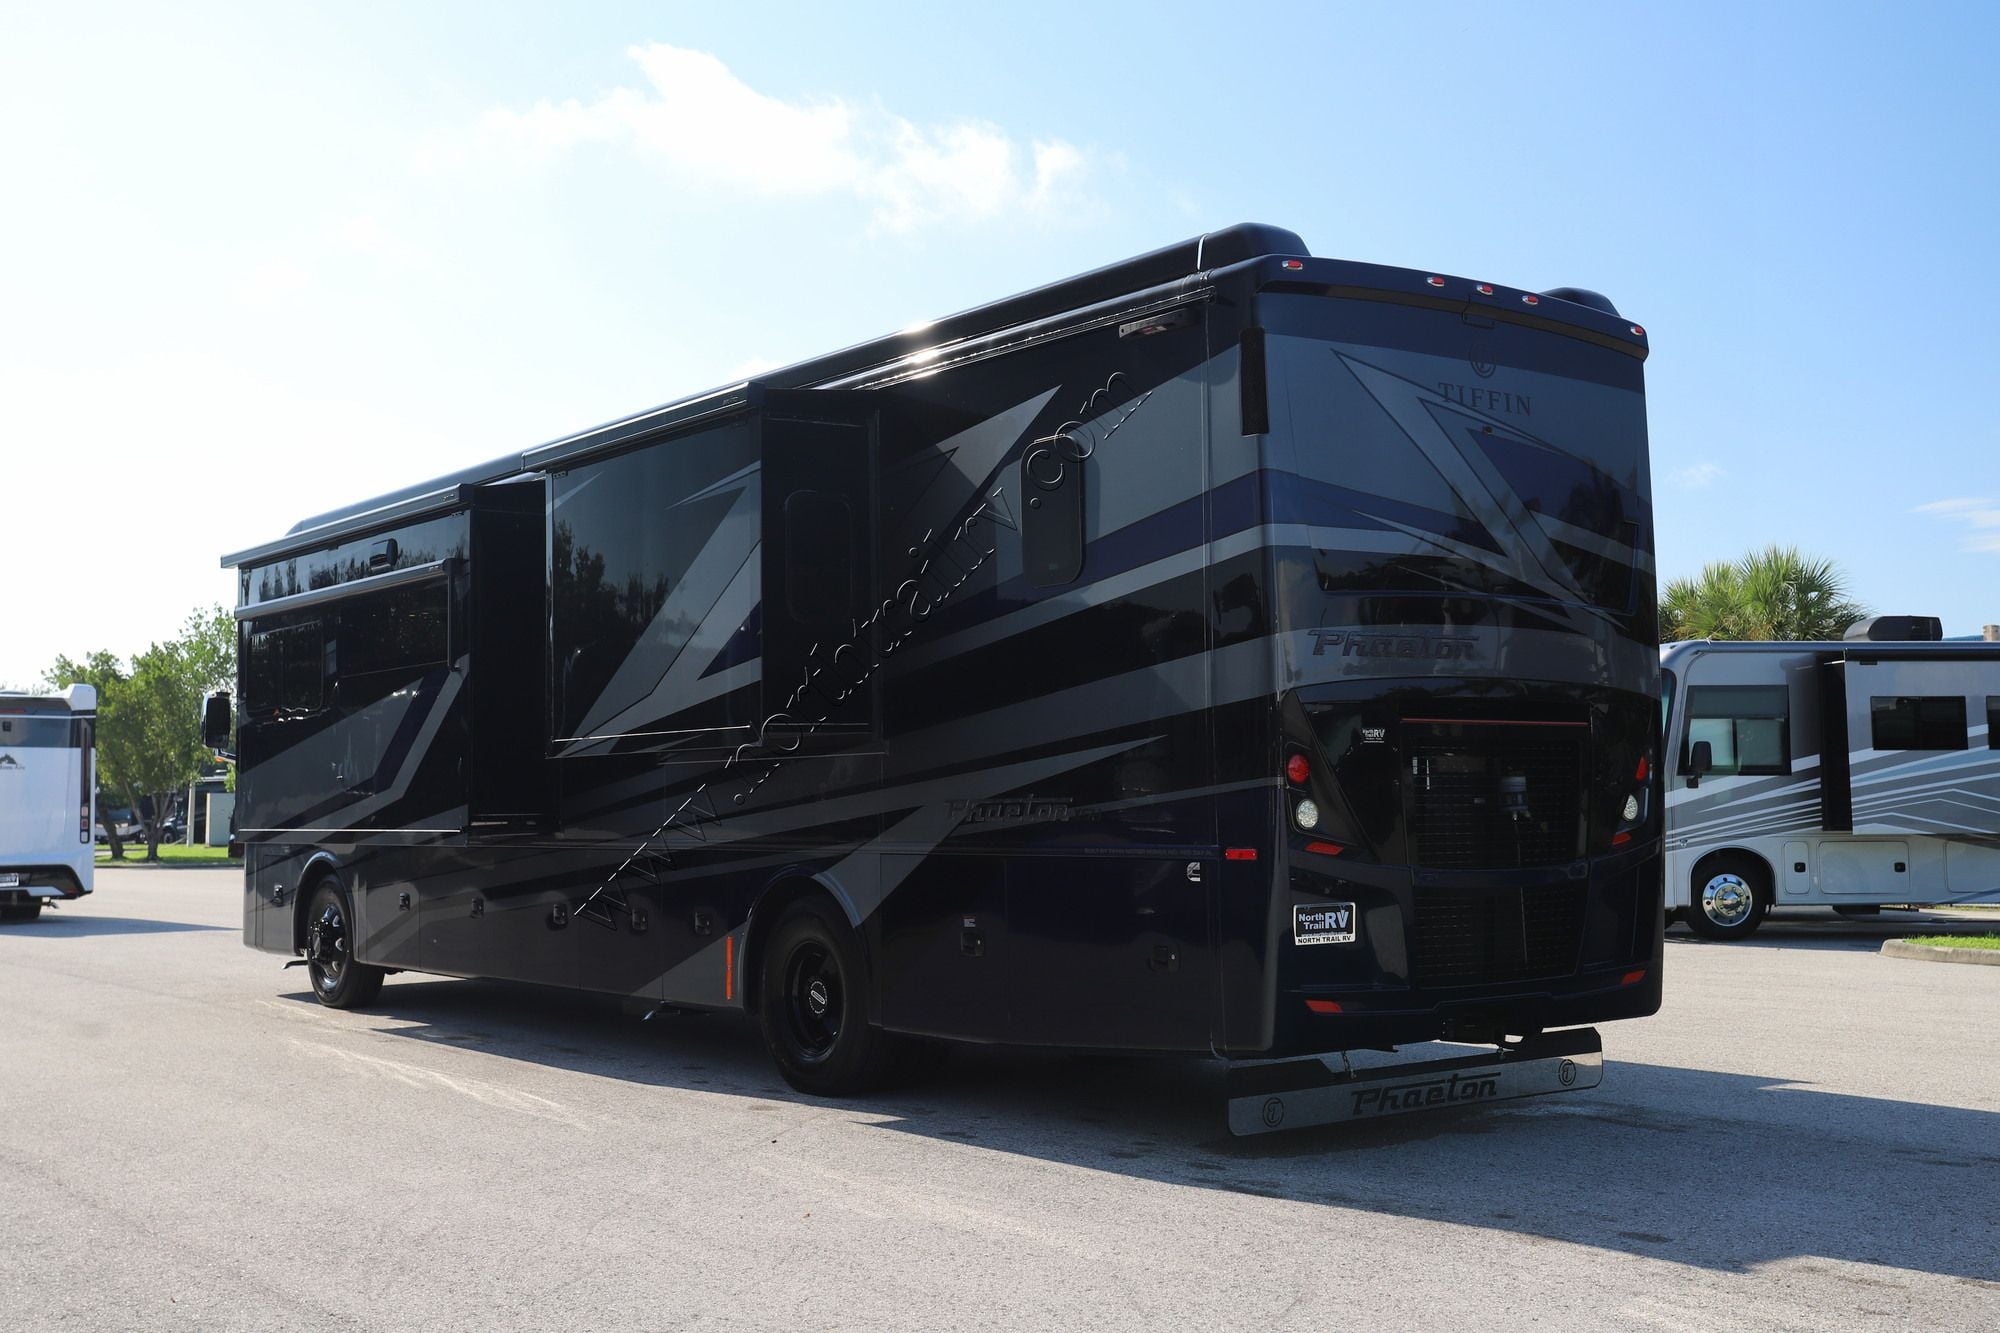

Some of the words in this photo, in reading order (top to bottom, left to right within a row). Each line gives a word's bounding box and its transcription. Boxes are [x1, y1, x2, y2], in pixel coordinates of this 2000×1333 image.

[1438, 382, 1532, 416] TIFFIN
[1307, 629, 1480, 660] Phaeton
[943, 792, 1073, 822] Phaeton
[1298, 912, 1324, 922] North
[1324, 909, 1349, 929] RV
[1303, 921, 1324, 930] Trail
[1351, 1072, 1501, 1115] Phaeton
